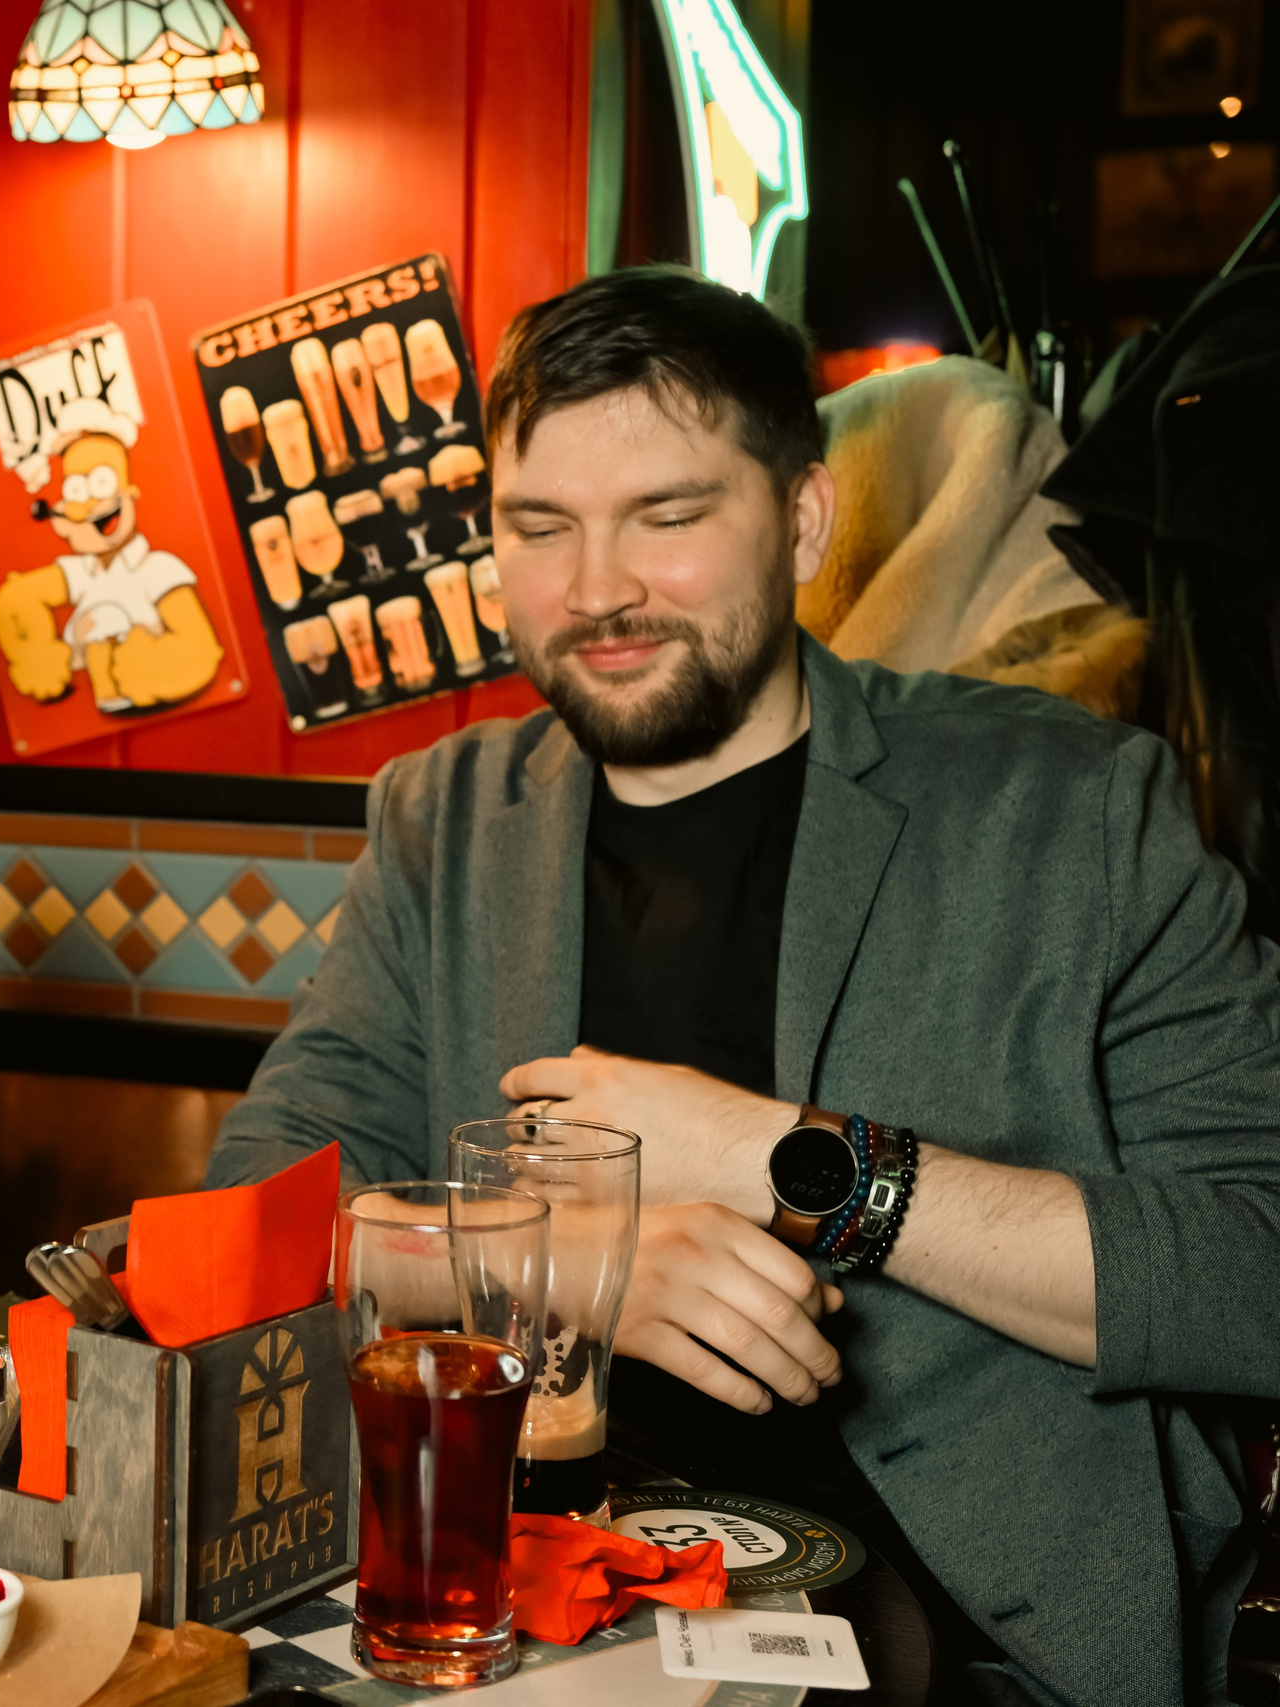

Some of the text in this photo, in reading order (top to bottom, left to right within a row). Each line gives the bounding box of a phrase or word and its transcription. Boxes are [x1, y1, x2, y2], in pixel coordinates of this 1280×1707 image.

[198, 260, 440, 368] CHEERS!
[701, 1496, 750, 1510] ТЕБЯ
[753, 1506, 812, 1529] НАЙТИ
[723, 1528, 774, 1554] СТОЛ
[732, 1541, 836, 1586] НАЗОВИ БАРМЕНУ
[212, 1545, 332, 1614] RISH PUB
